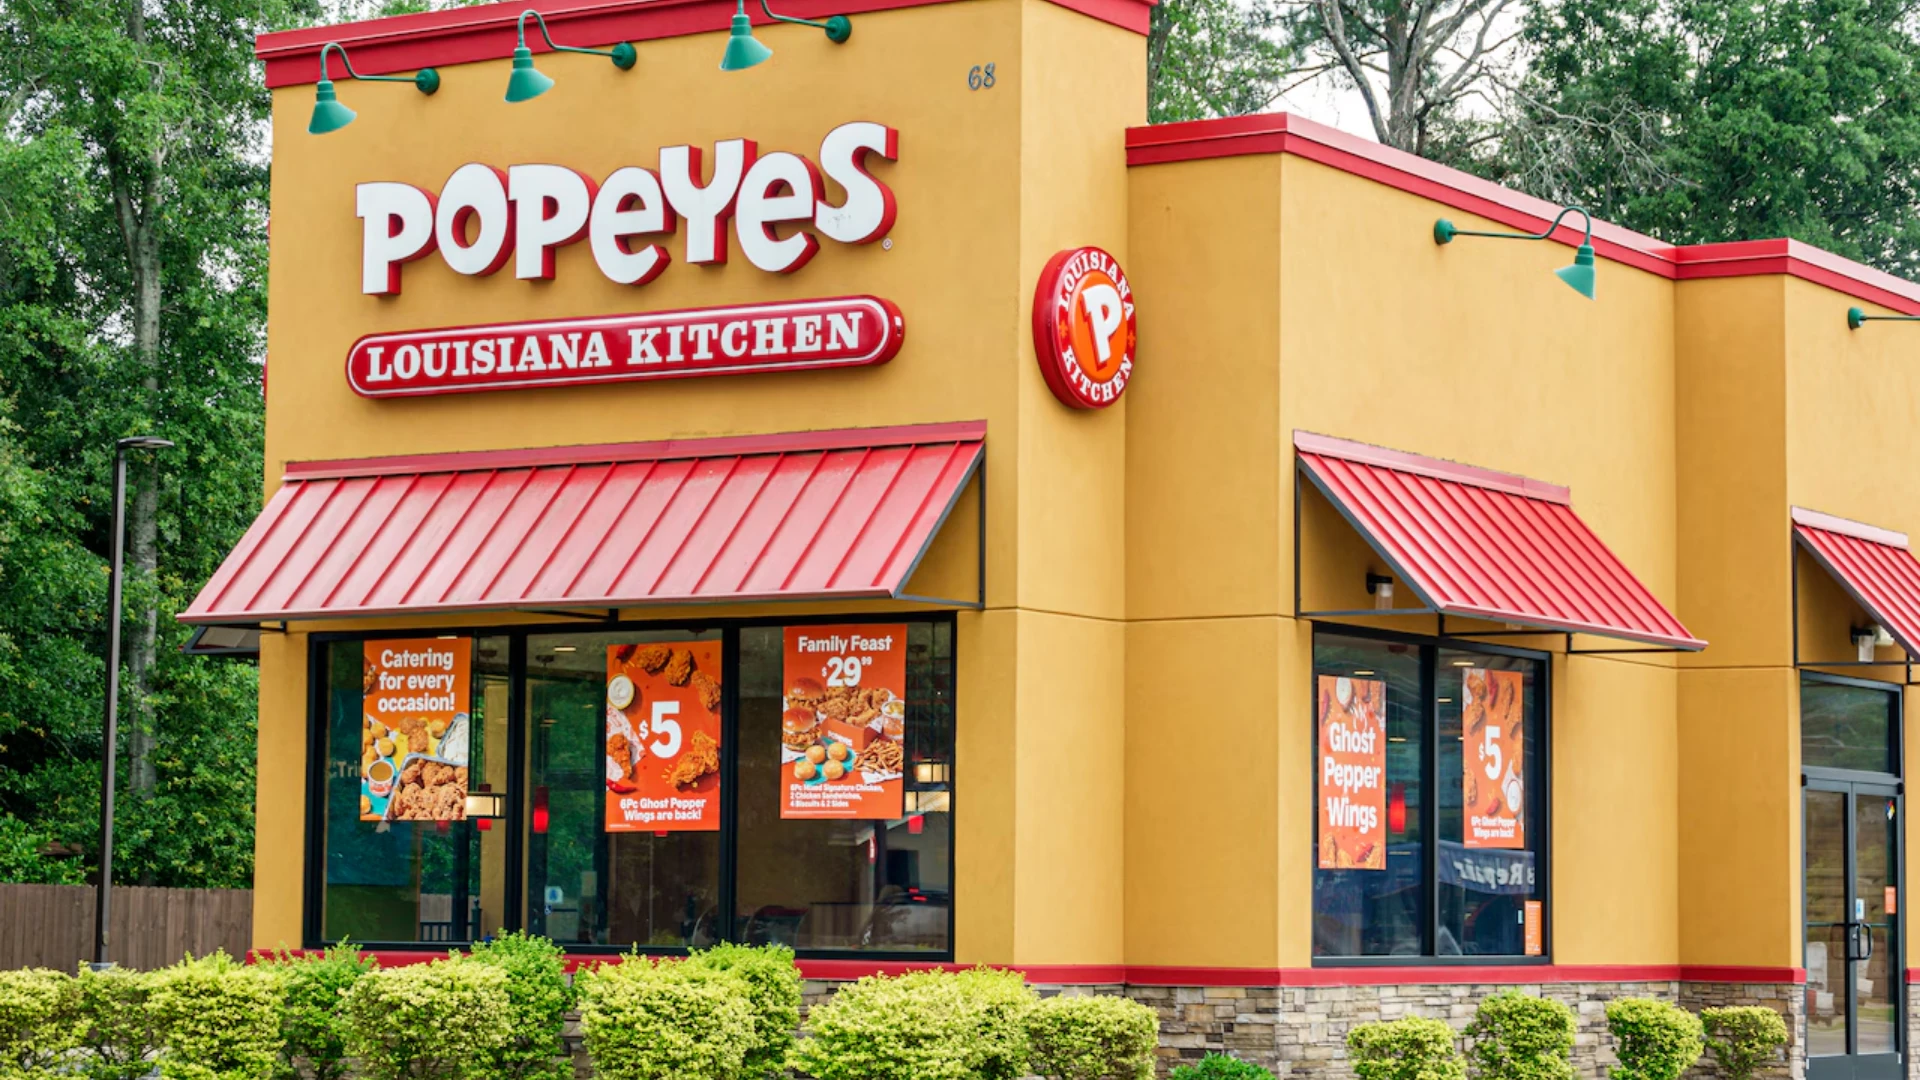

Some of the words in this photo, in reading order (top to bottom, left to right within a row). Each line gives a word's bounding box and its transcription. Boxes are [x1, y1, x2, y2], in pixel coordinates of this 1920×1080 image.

[968, 62, 996, 91] 68
[1059, 251, 1135, 321] LOUISIANA
[1082, 283, 1123, 364] P
[366, 331, 612, 382] LOUISIANA
[627, 312, 863, 364] KITCHEN
[1062, 345, 1134, 402] KITCHEN
[381, 648, 454, 670] Catering
[798, 636, 848, 655] Family
[851, 635, 892, 651] Feast
[379, 671, 405, 690] for
[407, 674, 455, 692] every
[378, 692, 455, 712] occasion!
[1329, 722, 1376, 754] Ghost
[1324, 756, 1381, 794] Pepper
[620, 798, 638, 809] 6Pc
[640, 798, 669, 808] Ghost
[670, 797, 707, 810] Pepper
[624, 810, 654, 823] Wings
[656, 812, 673, 820] are
[674, 809, 702, 820] back!
[1327, 797, 1377, 834] Wings
